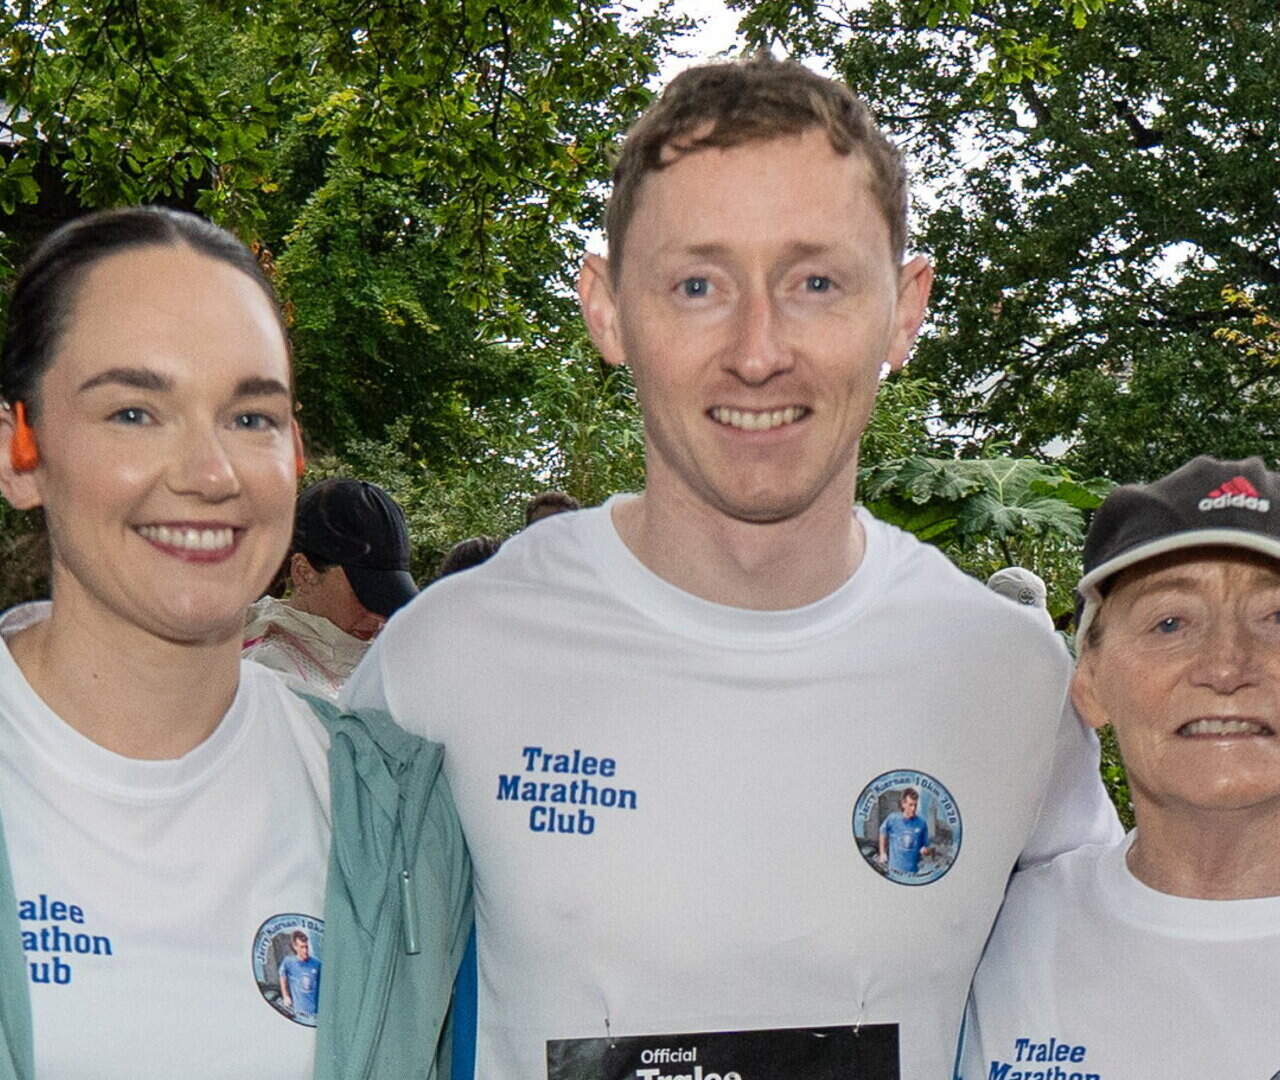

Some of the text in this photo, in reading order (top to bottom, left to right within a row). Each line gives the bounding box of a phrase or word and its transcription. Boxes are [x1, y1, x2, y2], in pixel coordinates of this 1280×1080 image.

[1197, 491, 1270, 513] adidas
[522, 745, 616, 777] Tralee
[497, 774, 637, 809] Marathon
[528, 805, 595, 835] Club
[18, 893, 84, 924] alee
[20, 925, 113, 955] athon
[24, 955, 71, 985] ub
[640, 1047, 697, 1065] Official
[1014, 1037, 1086, 1063] Tralee
